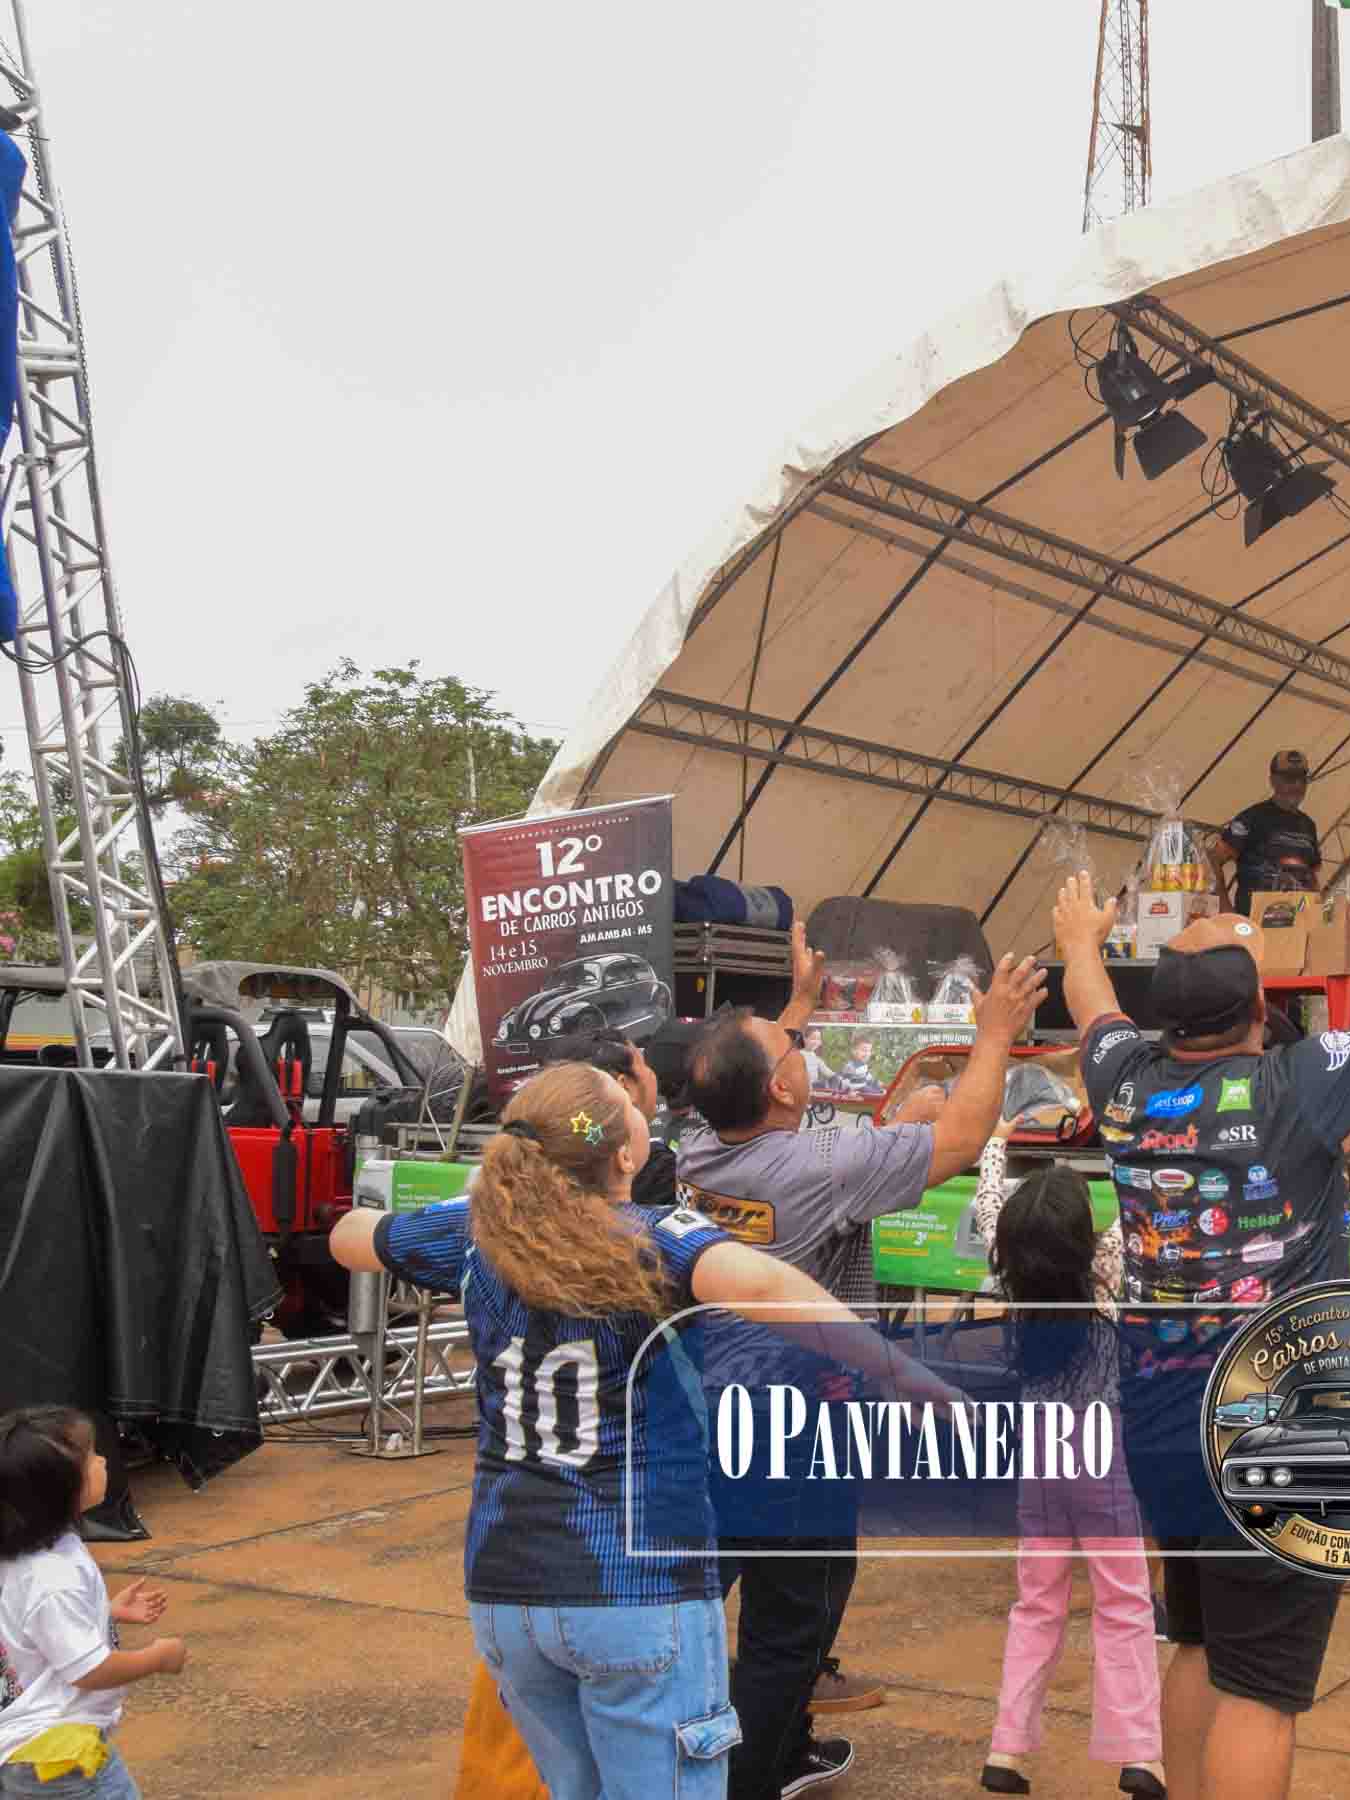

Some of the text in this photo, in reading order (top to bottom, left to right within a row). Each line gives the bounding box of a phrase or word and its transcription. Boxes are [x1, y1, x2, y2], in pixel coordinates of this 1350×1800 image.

[535, 834, 602, 878] 12º
[480, 869, 662, 922] ENCONTRO
[500, 900, 645, 938] DE CARROS ANTIGOS
[489, 940, 538, 961] 14 e 15
[579, 927, 632, 945] AMAMBAI
[482, 957, 549, 977] NOVEMBRO
[1229, 1125, 1257, 1142] SR
[491, 1336, 600, 1468] 10
